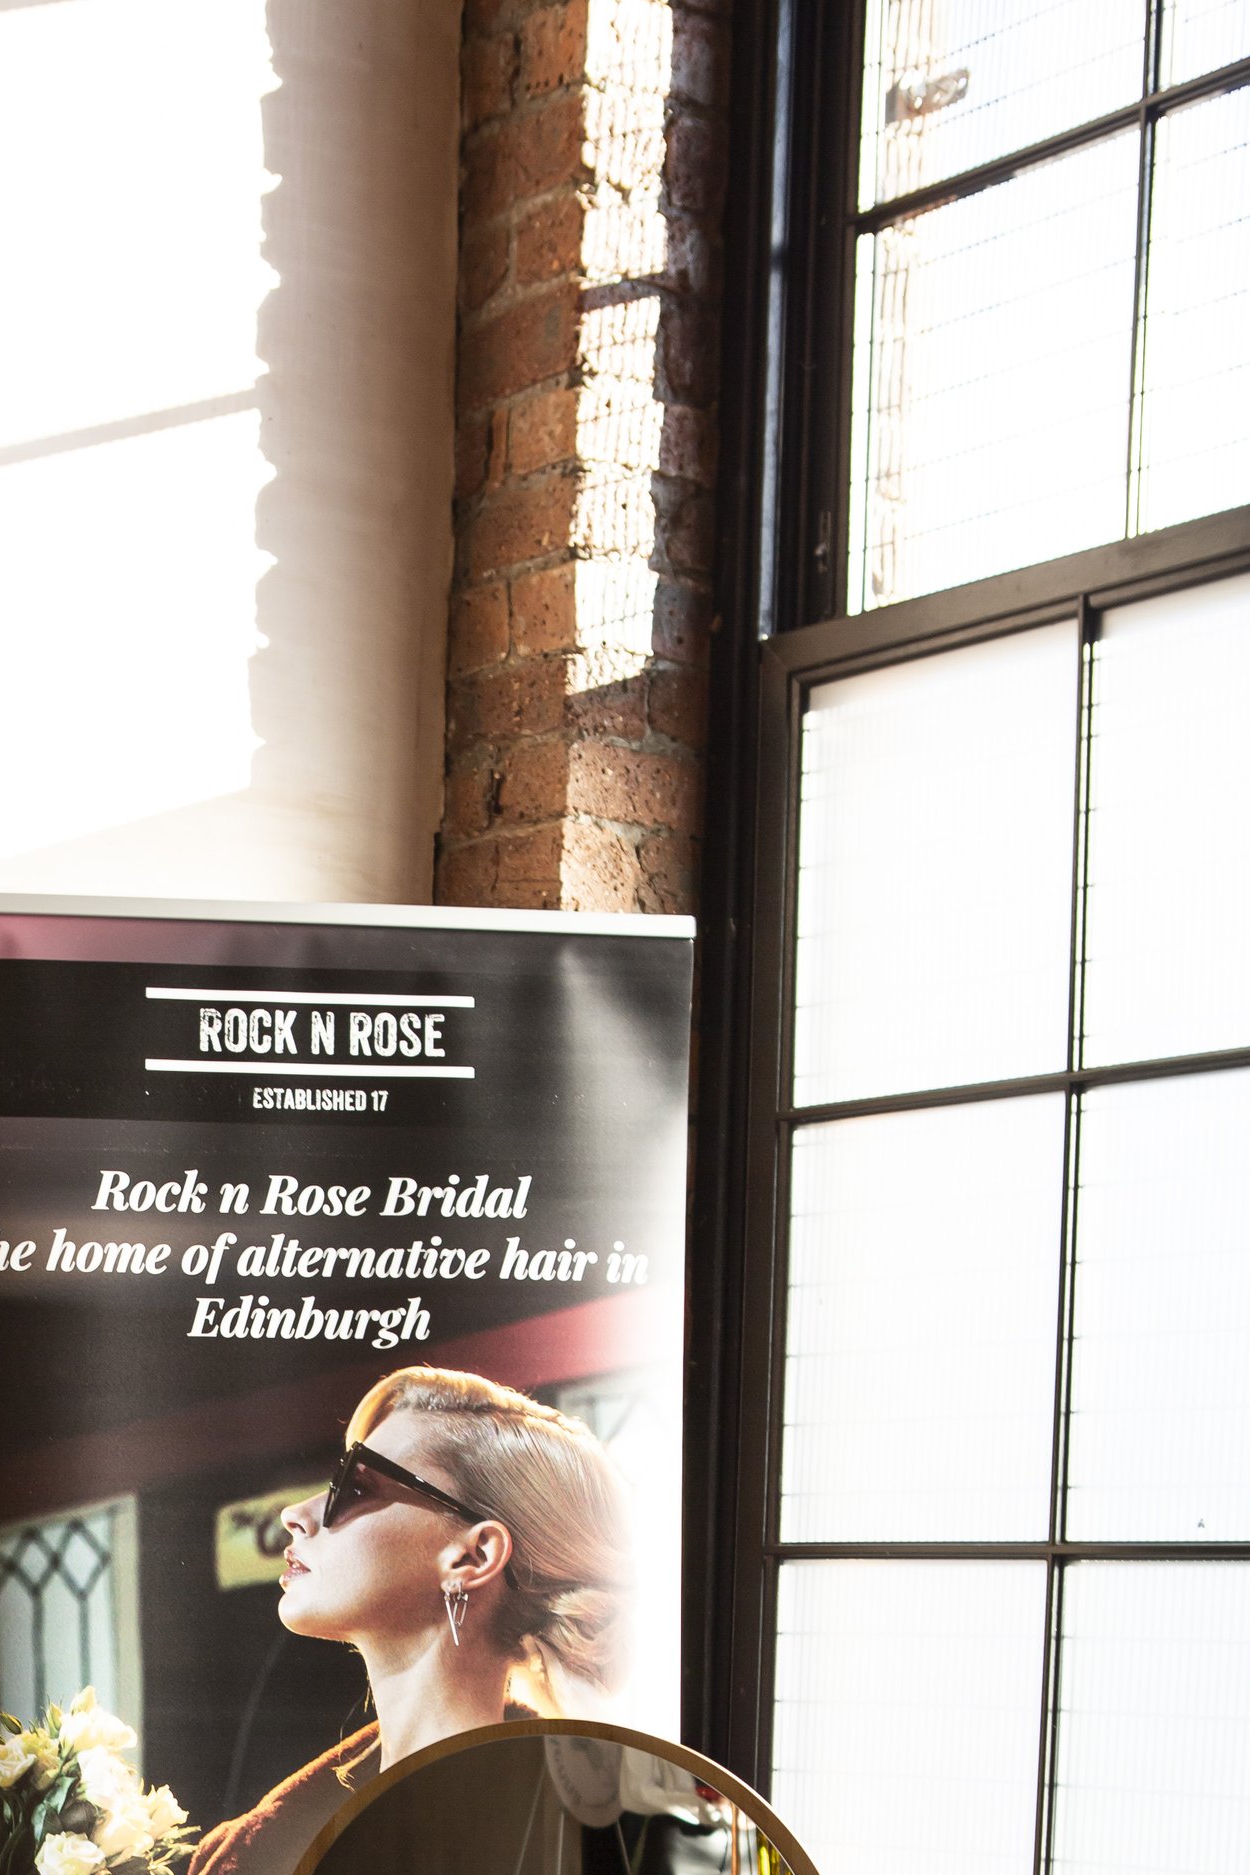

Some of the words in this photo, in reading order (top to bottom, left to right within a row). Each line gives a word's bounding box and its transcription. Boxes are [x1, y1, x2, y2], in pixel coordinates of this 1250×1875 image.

[199, 1007, 298, 1055] ROCK
[310, 1011, 335, 1056] N
[349, 1012, 446, 1058] ROSE
[252, 1087, 367, 1112] ESTABLISHED
[370, 1090, 389, 1112] 17
[91, 1170, 206, 1214] Rock
[219, 1184, 250, 1215] n
[260, 1175, 371, 1217] Rose
[380, 1174, 533, 1219] Bridal
[46, 1228, 171, 1275] home
[181, 1232, 238, 1285] of
[237, 1234, 491, 1280] alternative
[499, 1237, 598, 1282] hair
[606, 1239, 649, 1285] in
[187, 1295, 431, 1349] Edinburgh
